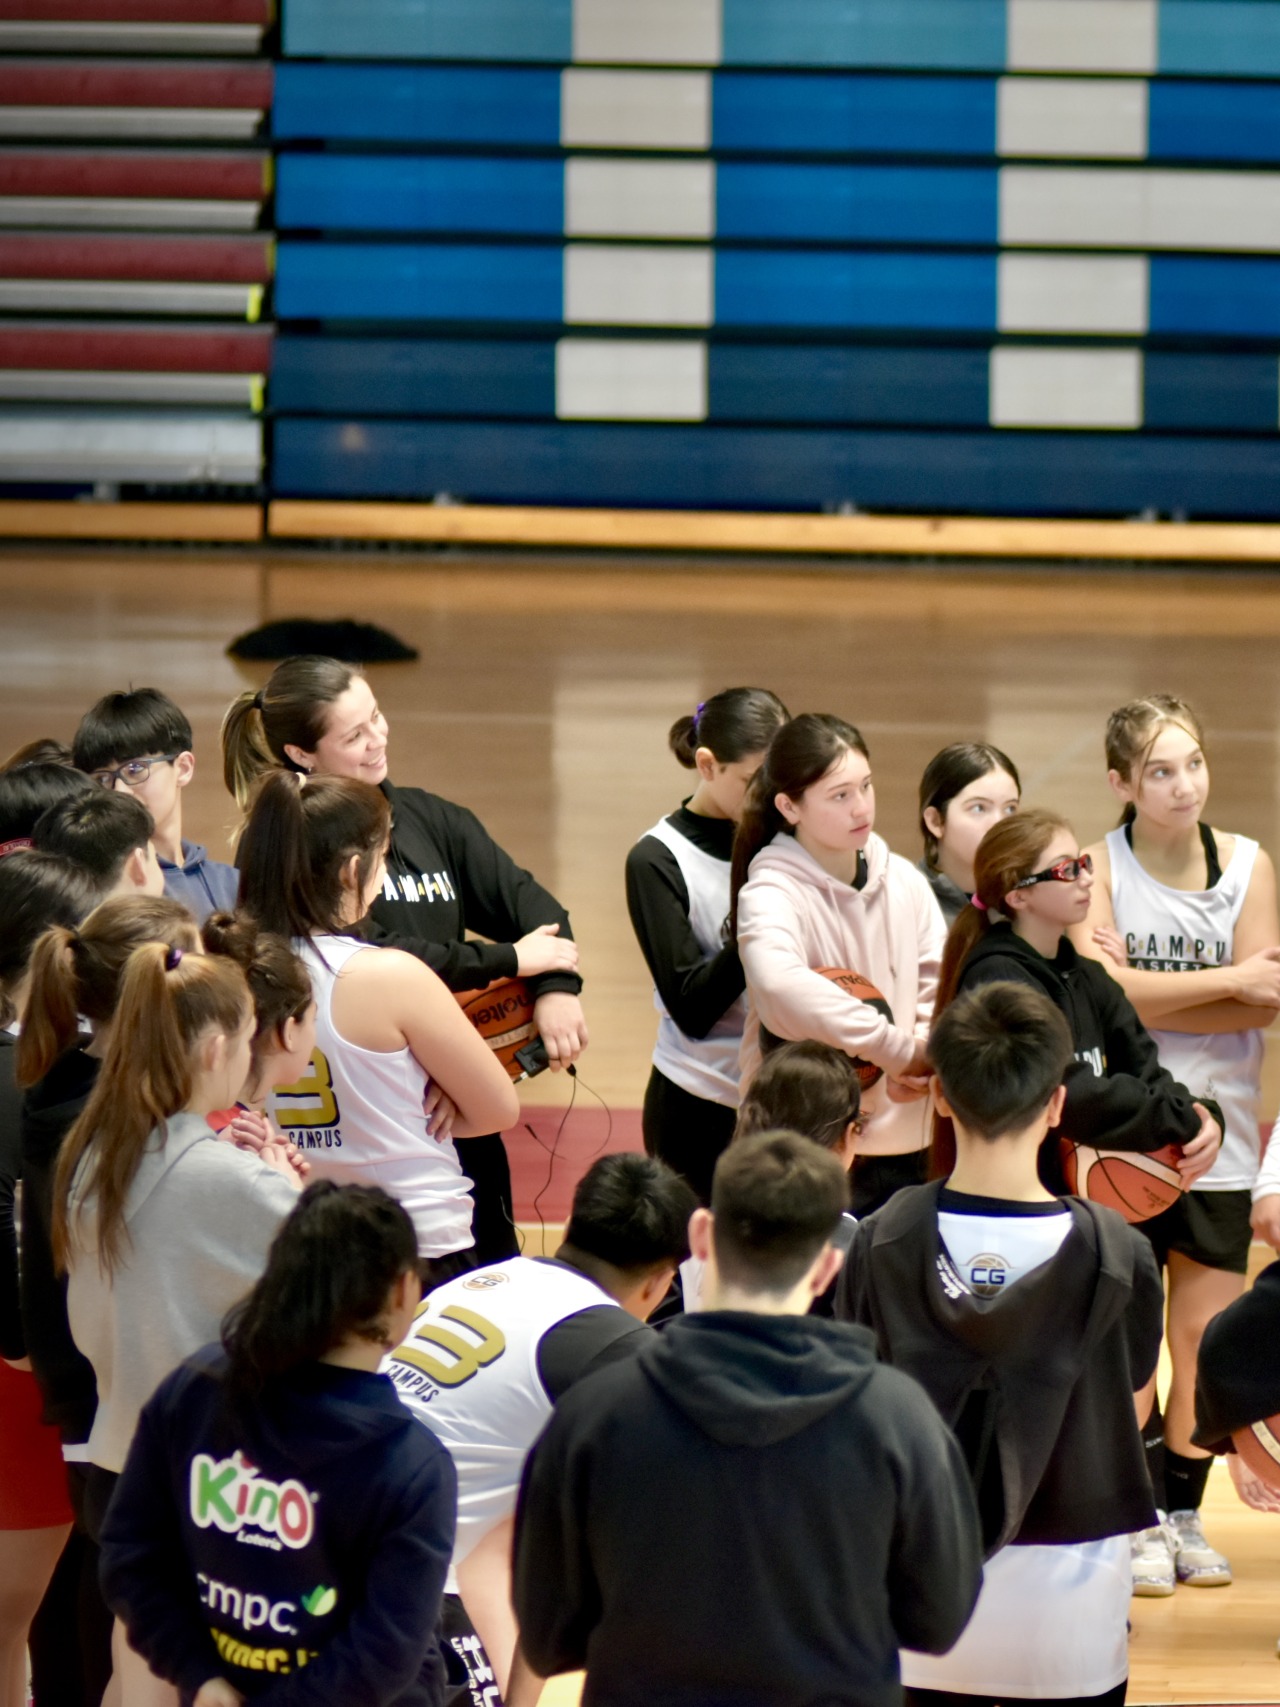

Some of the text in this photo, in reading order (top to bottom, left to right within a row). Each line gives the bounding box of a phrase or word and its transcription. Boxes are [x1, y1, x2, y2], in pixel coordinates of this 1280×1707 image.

[382, 870, 456, 903] AMU
[1125, 932, 1226, 962] CAMPU
[1127, 960, 1203, 972] ASKET
[267, 1046, 340, 1130] 3
[289, 1129, 342, 1149] CAMPUS
[971, 1268, 1005, 1285] CG
[389, 1302, 506, 1389] 3
[384, 1364, 440, 1403] CAMPUS
